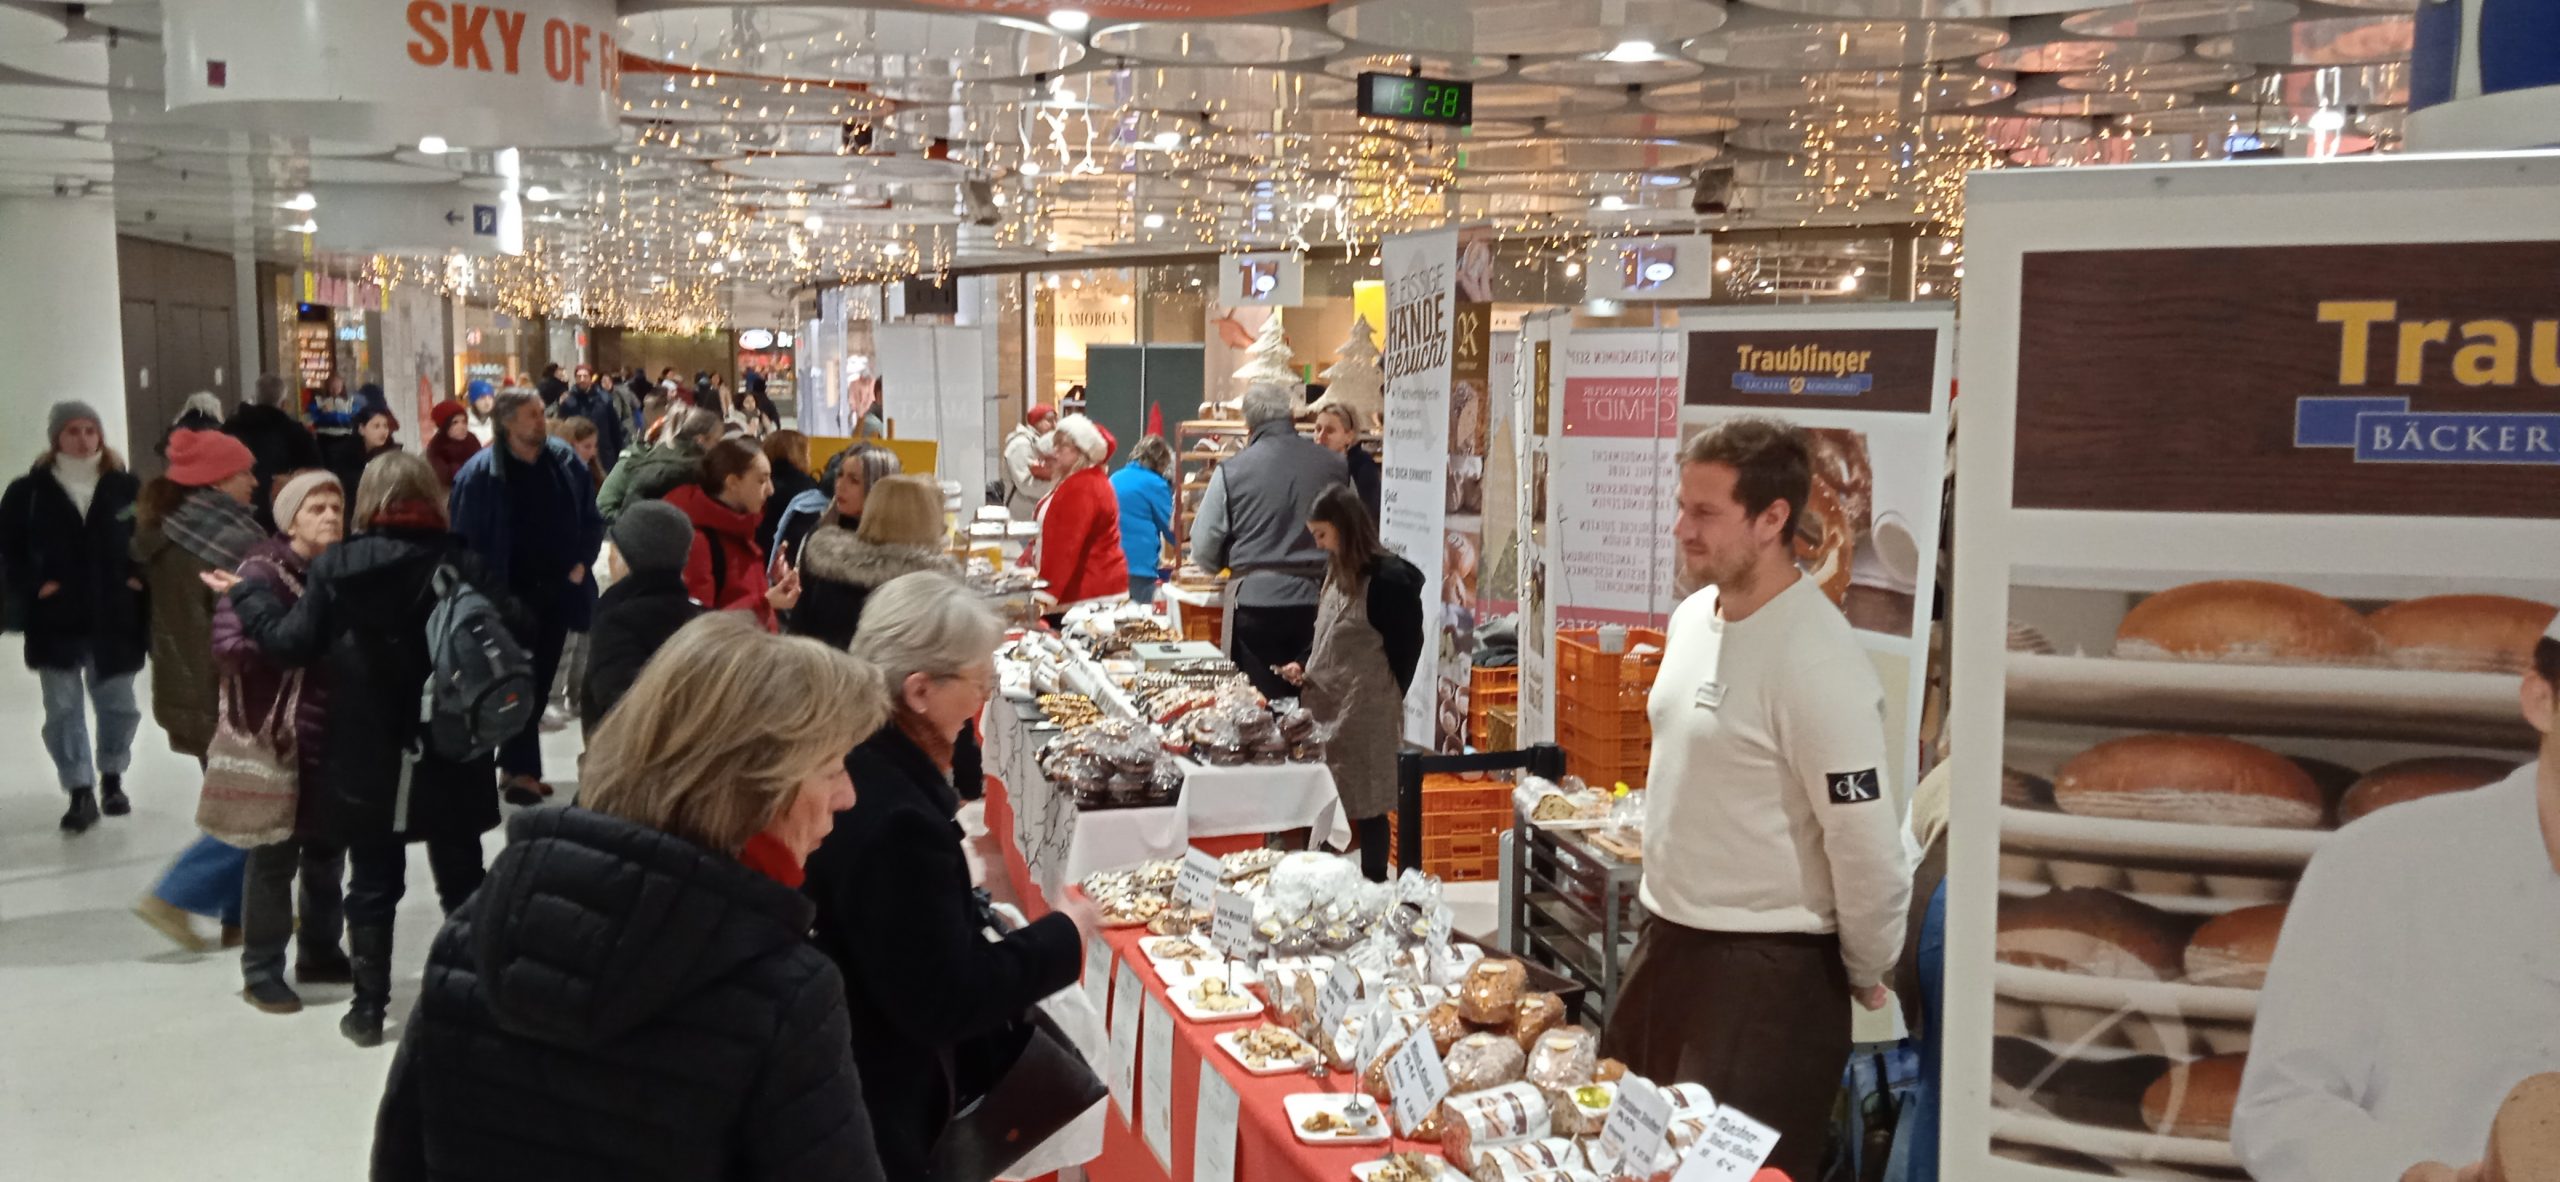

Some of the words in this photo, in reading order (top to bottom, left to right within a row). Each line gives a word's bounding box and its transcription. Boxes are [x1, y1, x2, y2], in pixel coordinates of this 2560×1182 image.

[406, 0, 526, 75] SKY
[544, 17, 592, 87] OF
[1388, 291, 1446, 354] HÄNDE
[1386, 328, 1448, 394] gesucht
[1737, 343, 1871, 379] Traublinger
[2373, 421, 2560, 452] BÄCKER
